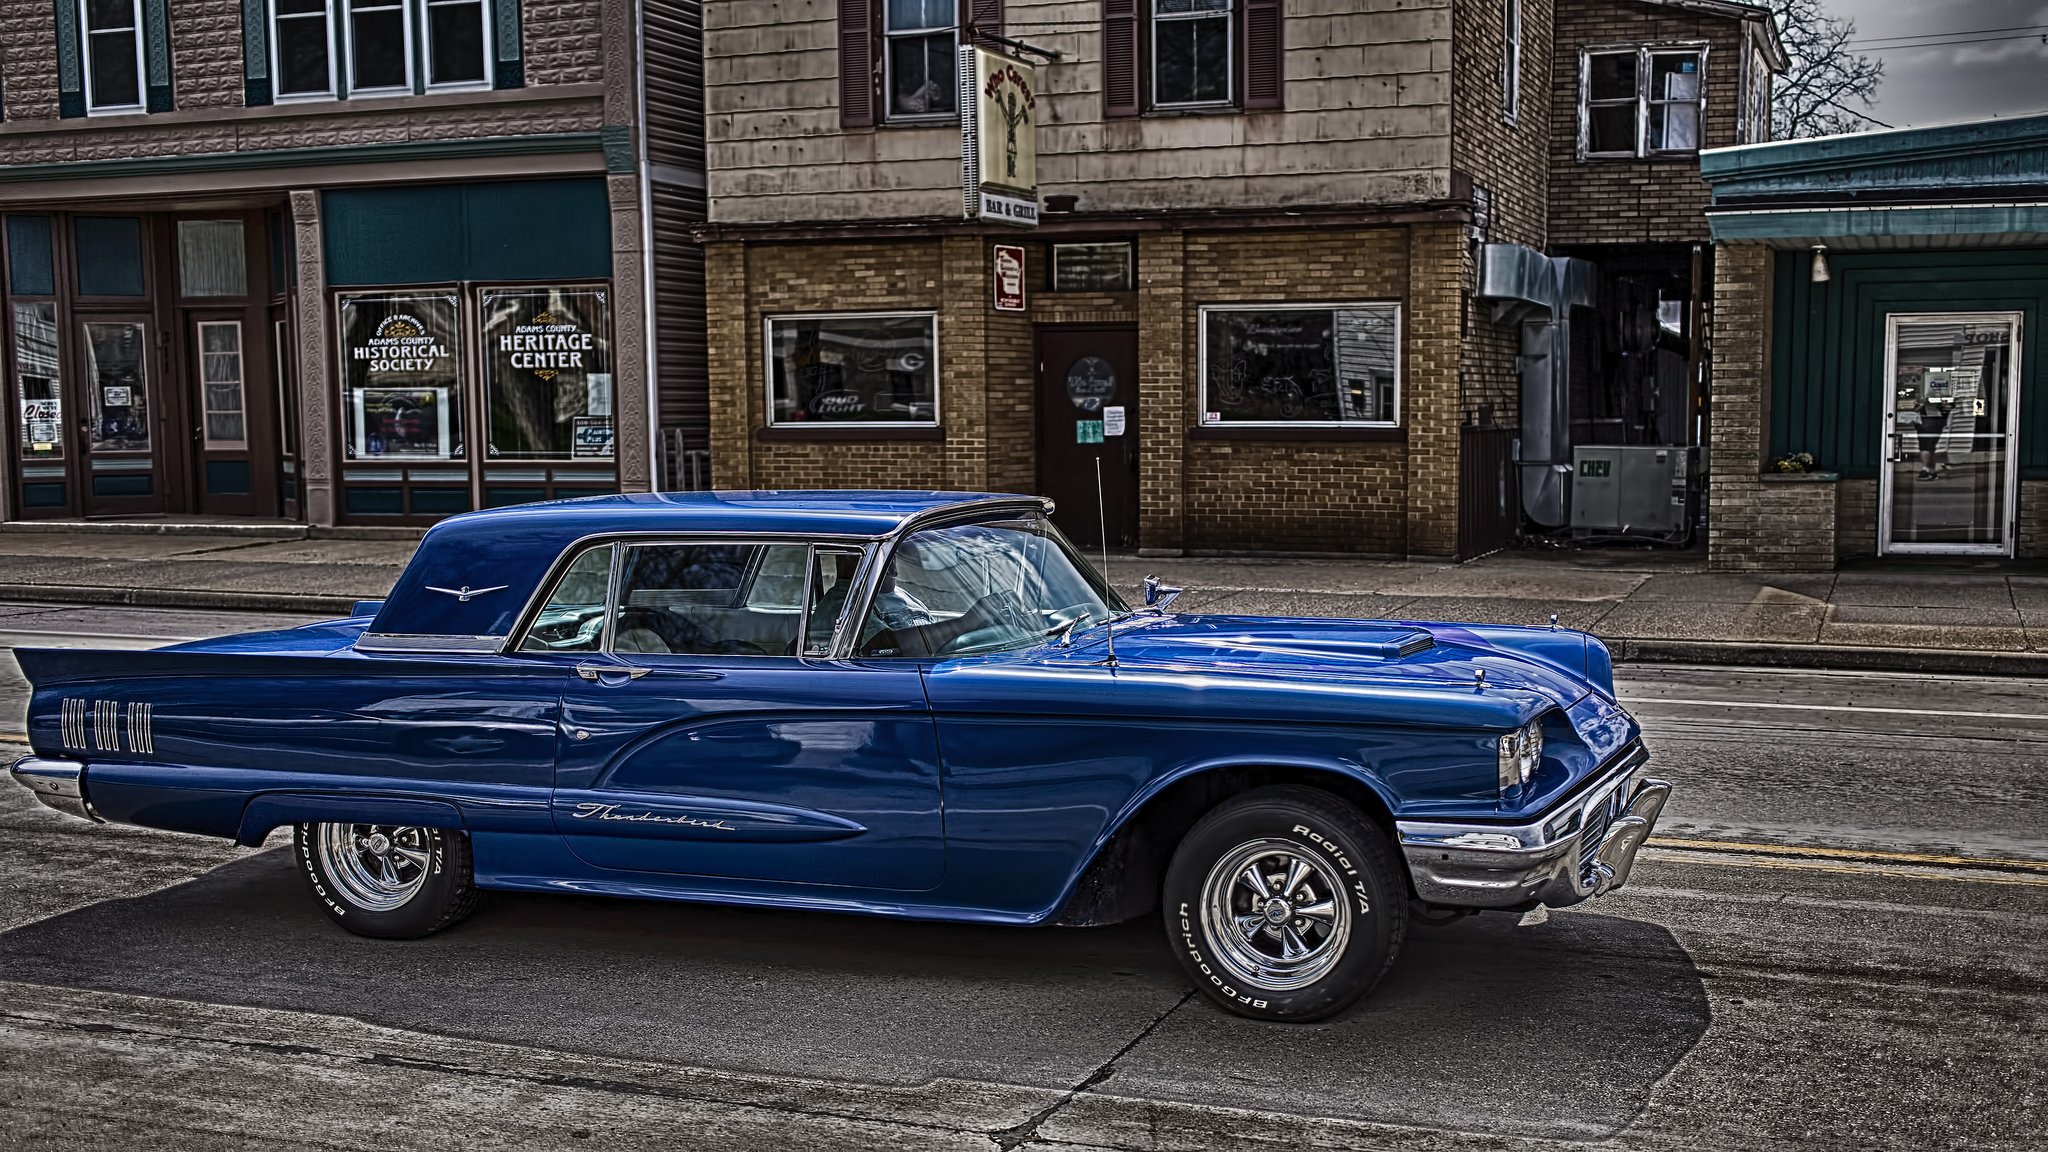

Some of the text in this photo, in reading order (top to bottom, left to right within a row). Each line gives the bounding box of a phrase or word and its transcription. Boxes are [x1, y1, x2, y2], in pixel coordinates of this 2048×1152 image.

[985, 69, 1005, 98] Who
[986, 199, 1036, 219] BAR & GRILL
[376, 316, 393, 337] OFFICE
[399, 314, 426, 336] ARCHIVES
[515, 324, 577, 333] ADAMS COUNTY
[368, 336, 435, 346] ADAMS COUNTY
[500, 333, 593, 351] HERITAGE
[353, 344, 450, 359] HISTORICAL
[510, 352, 583, 368] CENTER
[369, 358, 434, 372] SOCIETY
[818, 403, 867, 413] LIGHT
[821, 395, 859, 404] BUD
[572, 803, 736, 831] Thunderbird
[301, 822, 346, 916] BFGoodric
[434, 847, 443, 875] T/A
[1292, 824, 1371, 915] Radial T/A
[1179, 902, 1268, 1009] BFGoodrich
